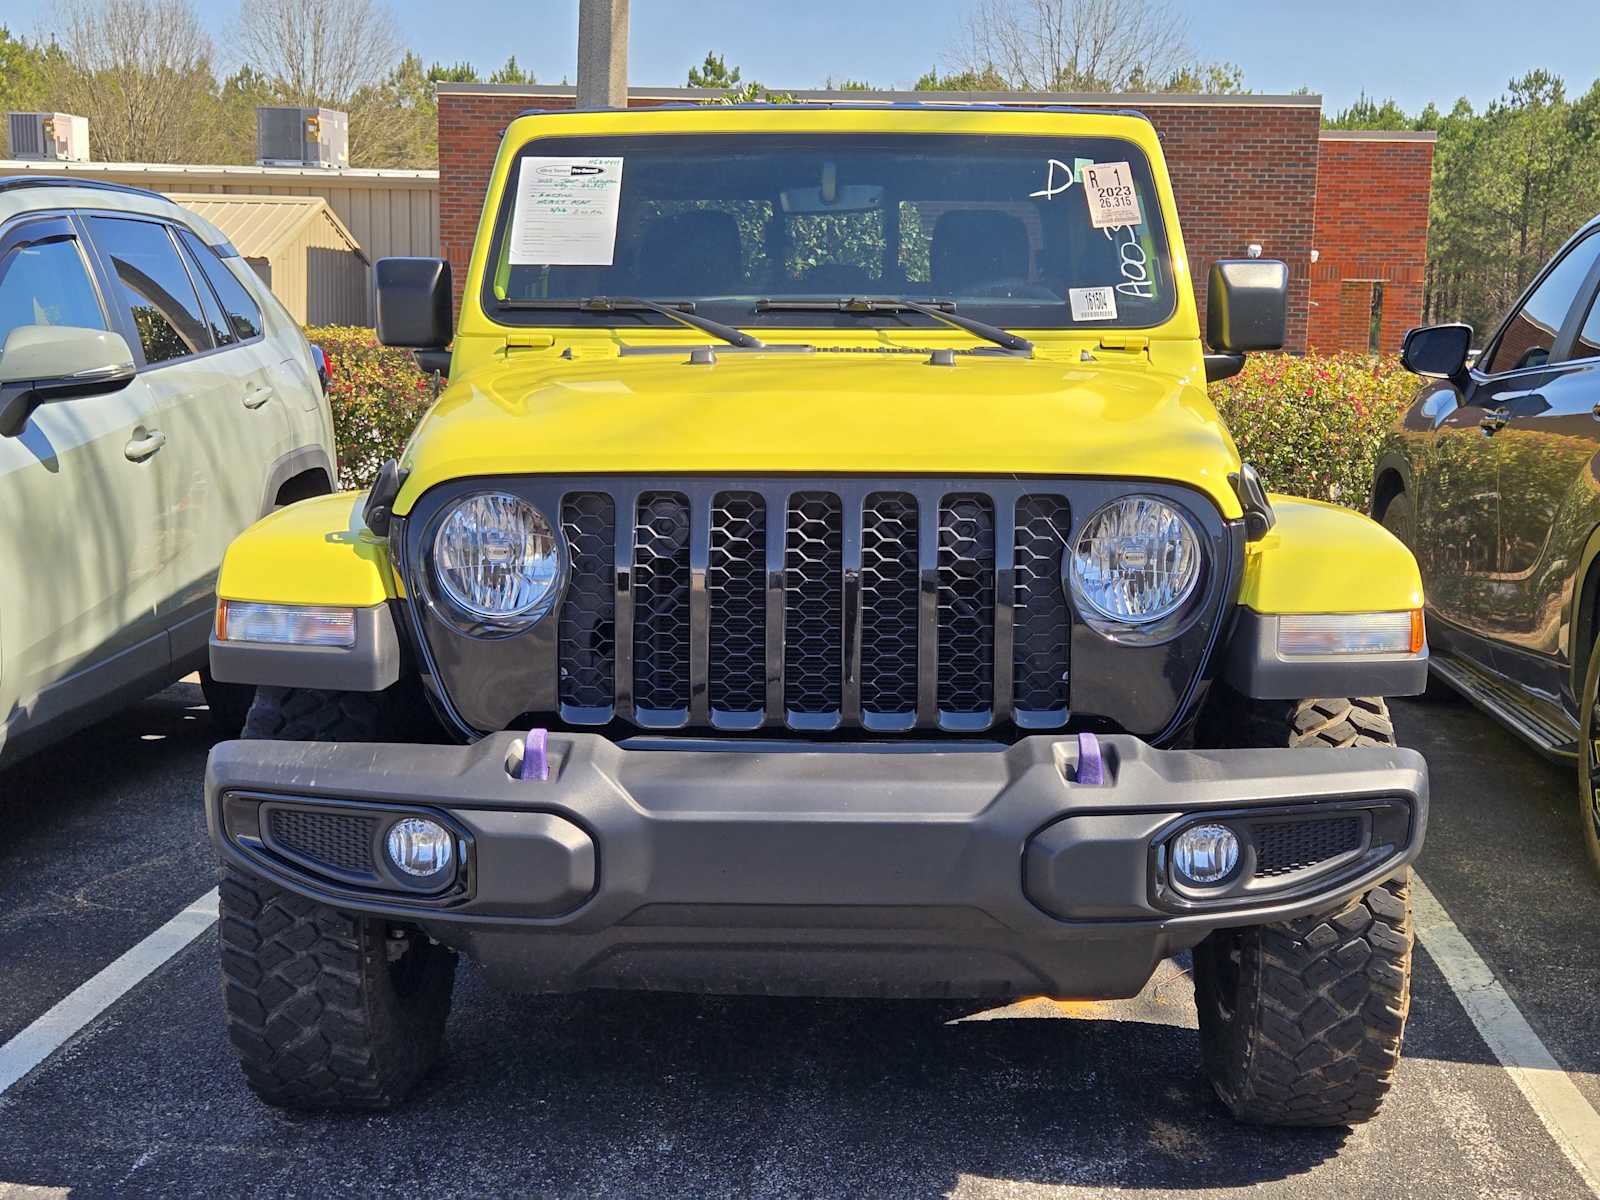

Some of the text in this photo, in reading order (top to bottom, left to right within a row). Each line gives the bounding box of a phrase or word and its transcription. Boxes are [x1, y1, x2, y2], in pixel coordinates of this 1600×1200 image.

[1088, 168, 1121, 188] R 1
[1097, 186, 1132, 198] 2023
[1085, 291, 1108, 311] 161504
